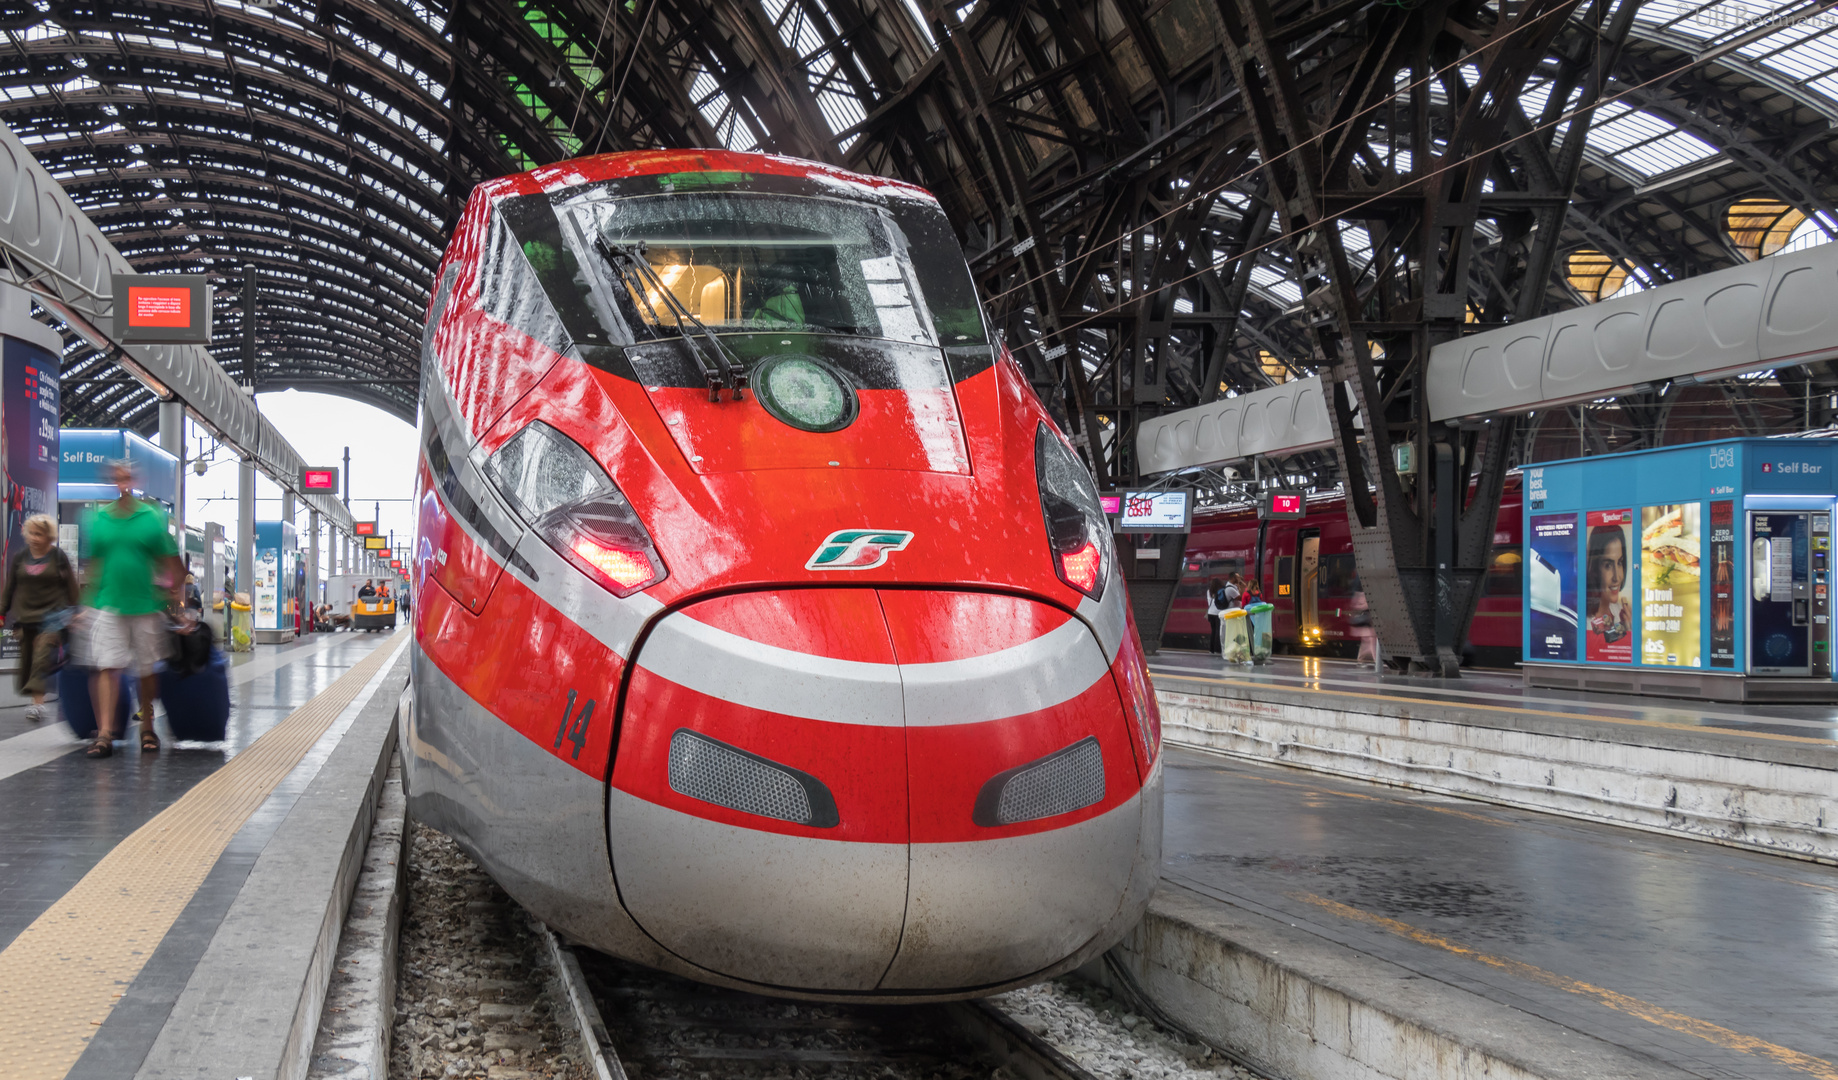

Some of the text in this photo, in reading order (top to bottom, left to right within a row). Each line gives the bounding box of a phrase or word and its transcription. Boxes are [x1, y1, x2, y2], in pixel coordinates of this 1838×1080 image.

[63, 451, 84, 462] Self
[86, 452, 104, 463] Bar
[1777, 462, 1822, 473] Self Bar
[1530, 468, 1544, 478] your
[1530, 479, 1543, 489] best
[1530, 489, 1547, 500] break
[1716, 486, 1725, 494] Self
[1282, 499, 1290, 507] 10
[1530, 500, 1544, 510] .com
[1711, 503, 1733, 513] GUSTO
[1128, 507, 1152, 517] COSTO
[1645, 588, 1672, 601] Lo trovi
[1645, 604, 1683, 617] al Self Bar
[1645, 620, 1666, 631] aperto
[554, 688, 596, 760] 14
